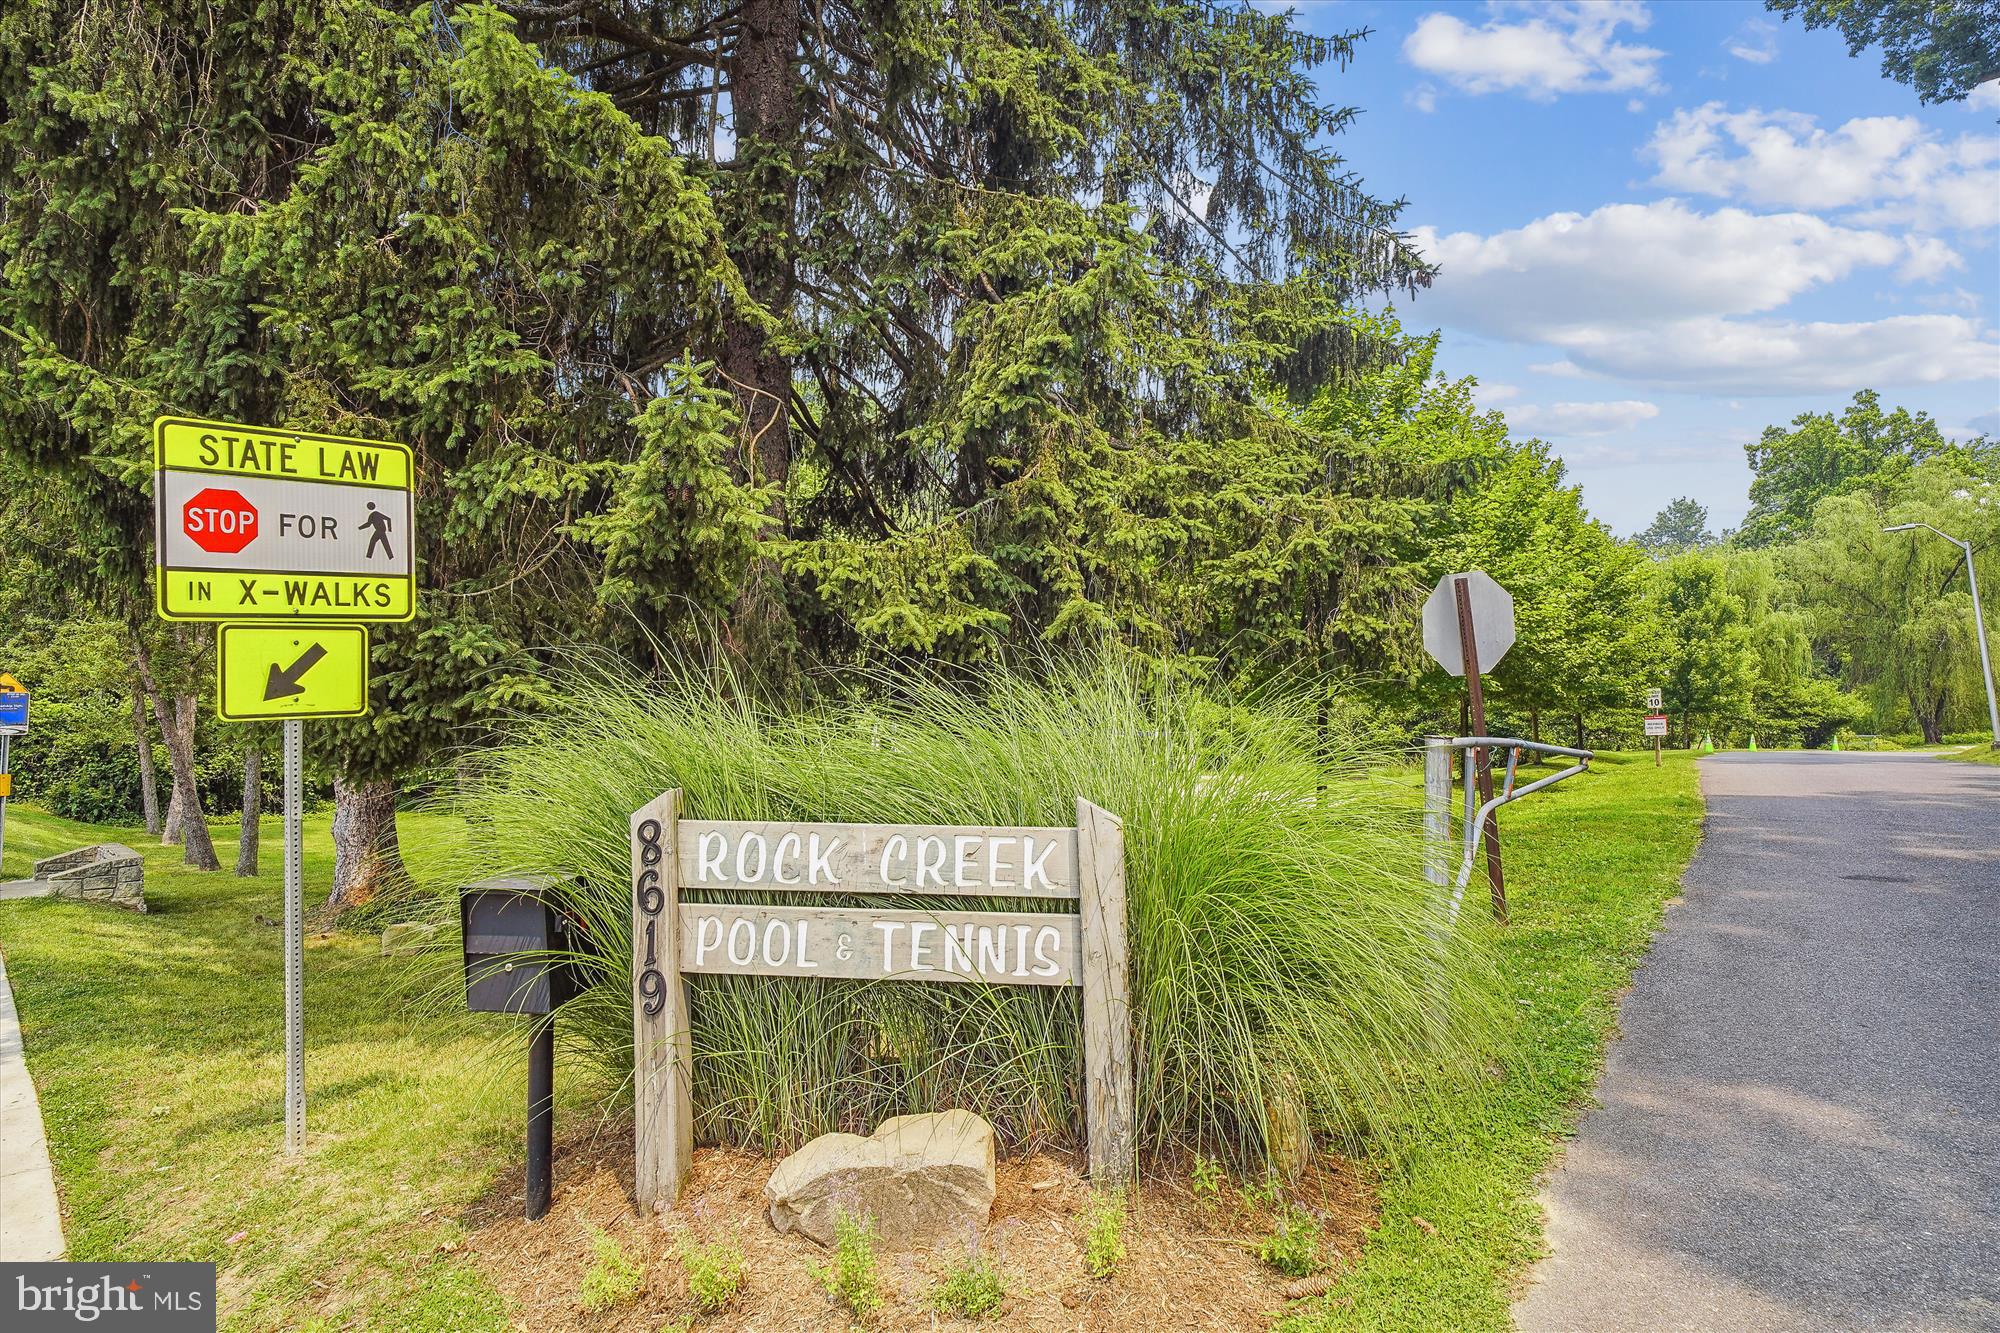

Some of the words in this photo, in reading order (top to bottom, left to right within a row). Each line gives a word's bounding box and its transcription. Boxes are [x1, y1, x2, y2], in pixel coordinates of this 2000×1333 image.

[199, 434, 298, 474] STATE
[319, 447, 380, 481] LAW
[187, 507, 254, 534] STOP
[279, 513, 338, 540] FOR
[189, 581, 211, 601] IN
[238, 579, 391, 607] X-WALKS
[1649, 698, 1660, 706] 10
[698, 830, 846, 886] ROCK
[880, 833, 1059, 891] CREEK
[636, 819, 668, 1017] 8619
[696, 915, 818, 969] POOL
[835, 933, 853, 961] &
[872, 920, 1061, 978] TENNIS
